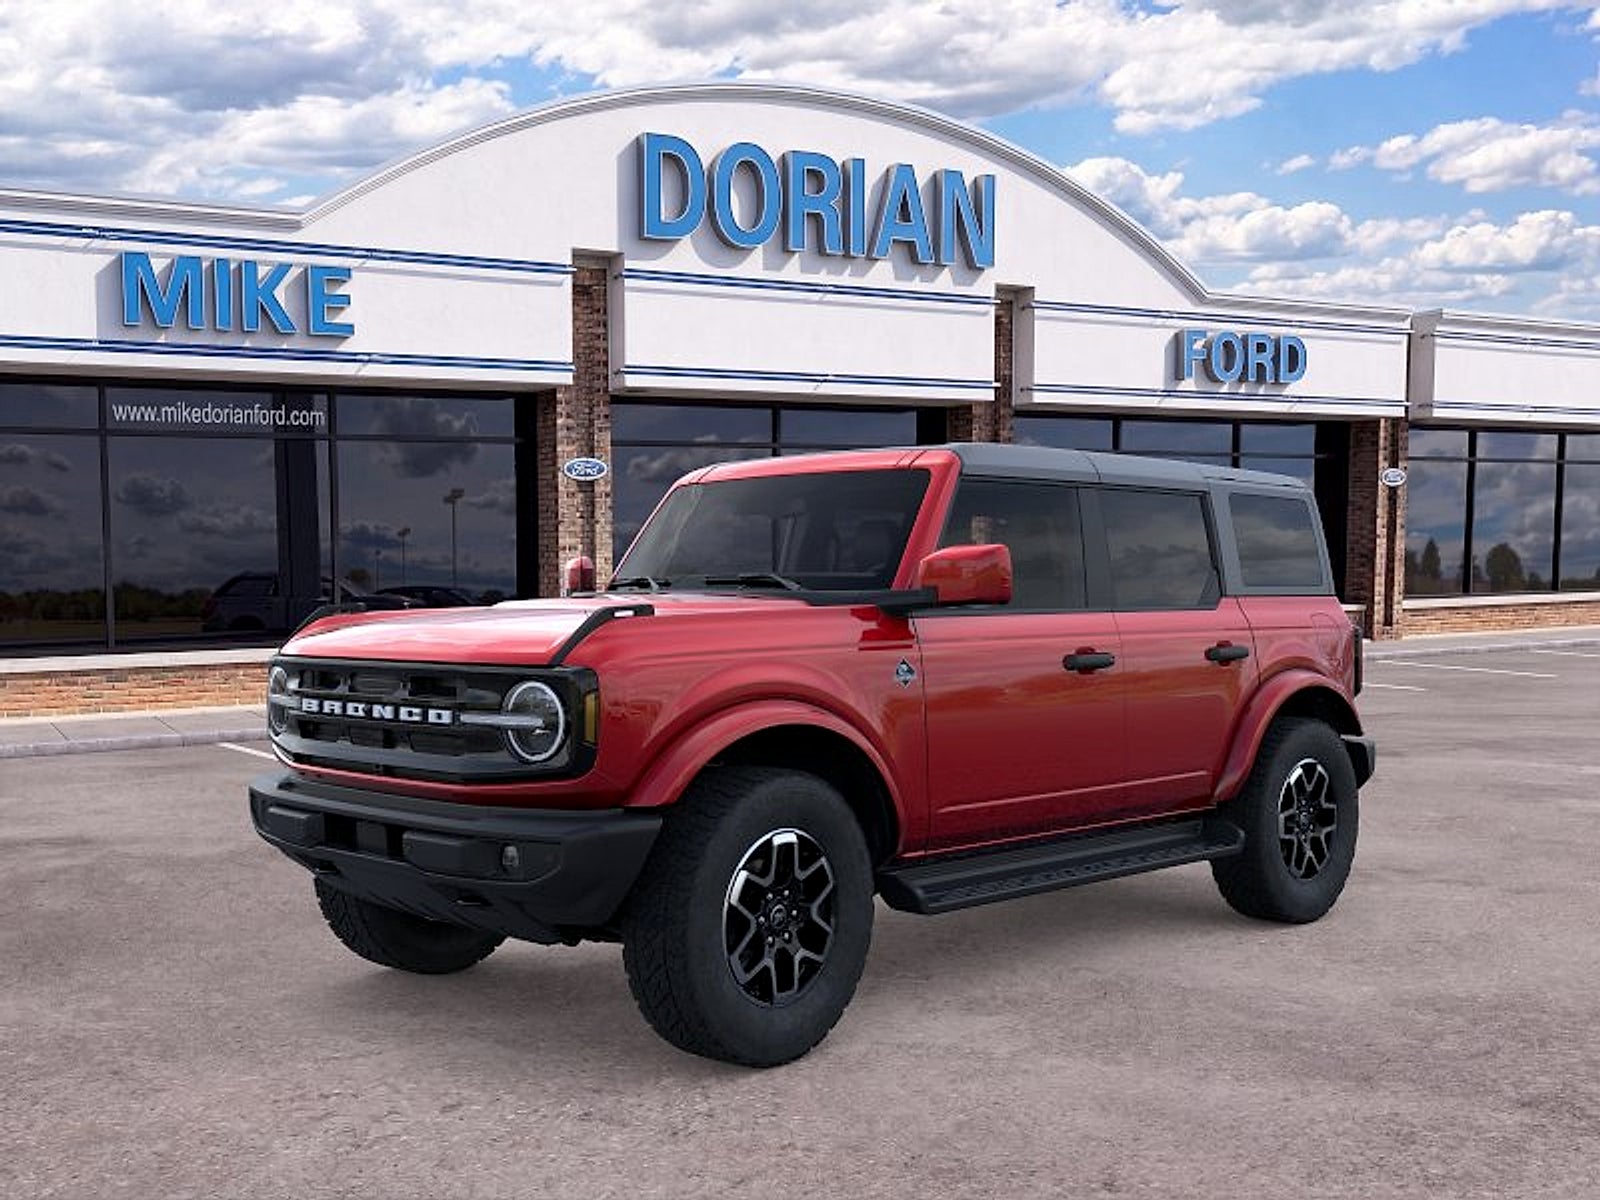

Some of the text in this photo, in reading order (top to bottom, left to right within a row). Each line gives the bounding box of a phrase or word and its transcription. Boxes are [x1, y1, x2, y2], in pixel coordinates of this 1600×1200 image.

[640, 131, 996, 269] DORIAN
[122, 251, 355, 337] MIKE
[1180, 327, 1307, 384] FORD
[112, 401, 325, 427] www.mikedorianford.com
[301, 697, 453, 724] BRONCO
